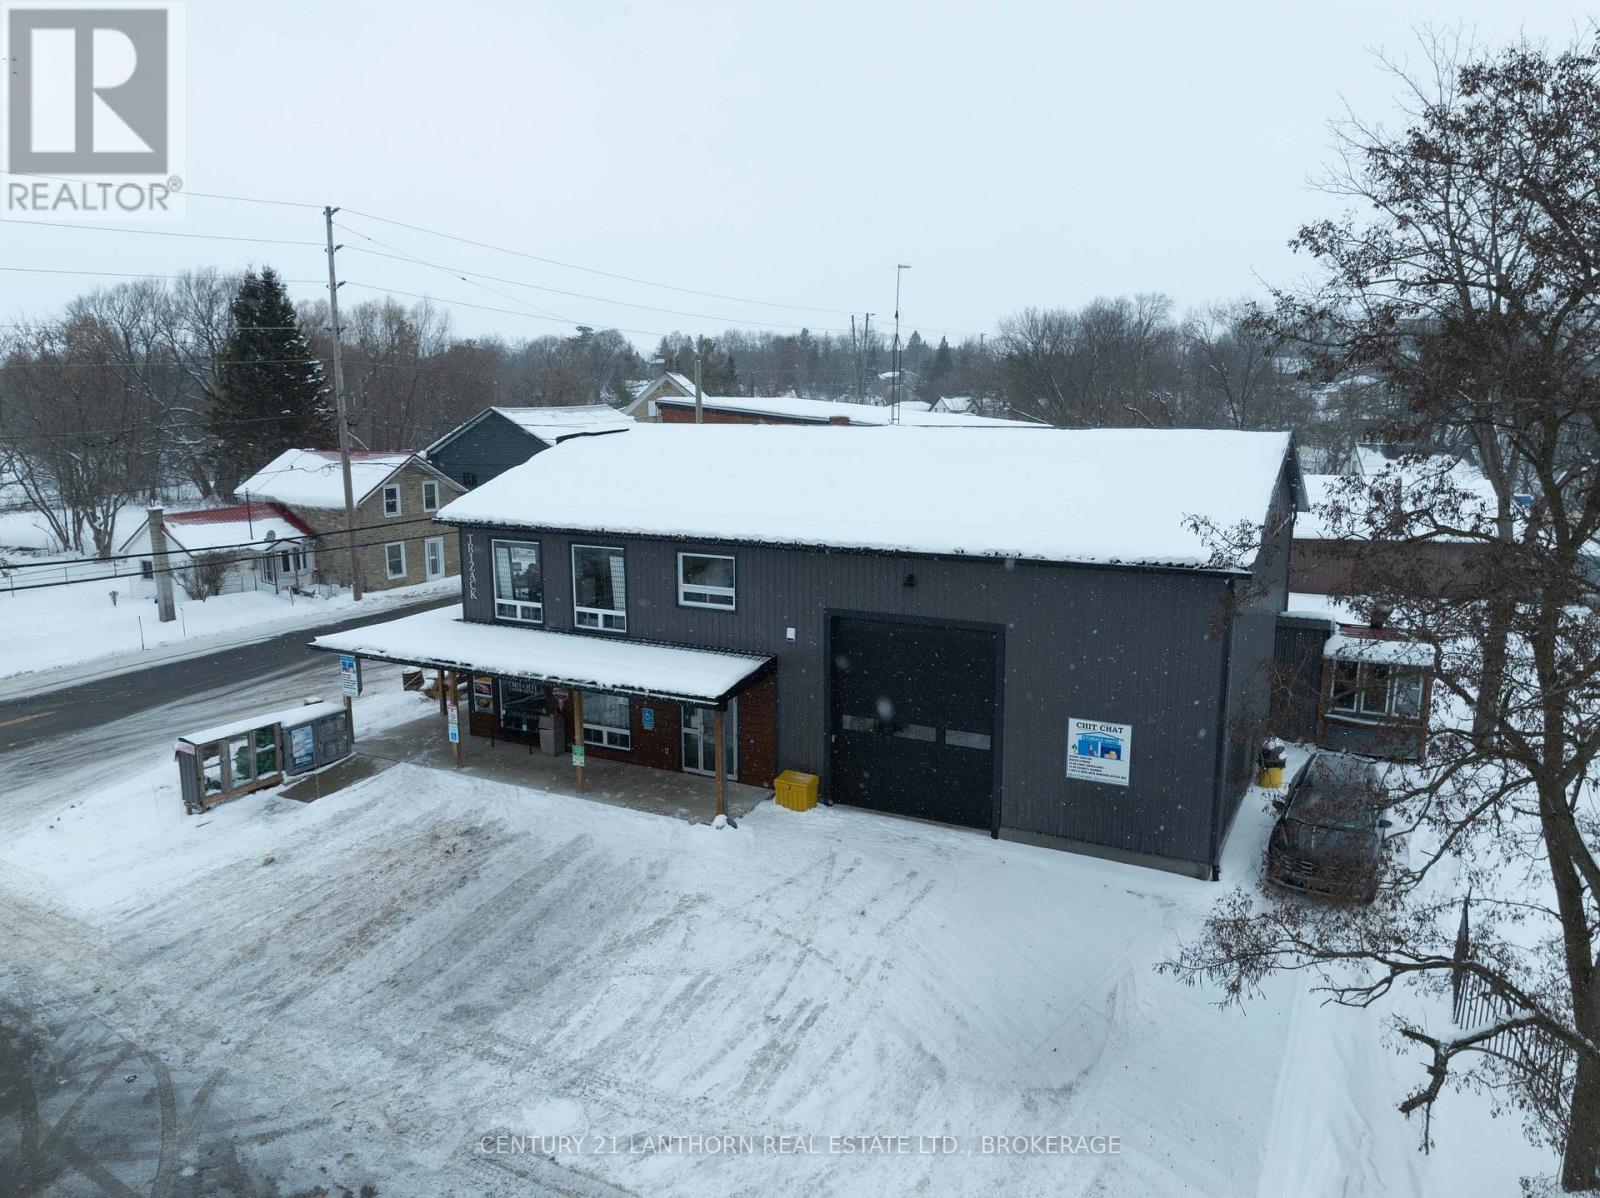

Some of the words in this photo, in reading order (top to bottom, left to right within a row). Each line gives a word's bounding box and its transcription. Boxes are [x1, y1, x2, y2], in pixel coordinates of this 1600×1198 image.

[466, 533, 478, 600] TRIZACK
[1076, 721, 1098, 731] CHIT
[1099, 725, 1124, 734] CHAT
